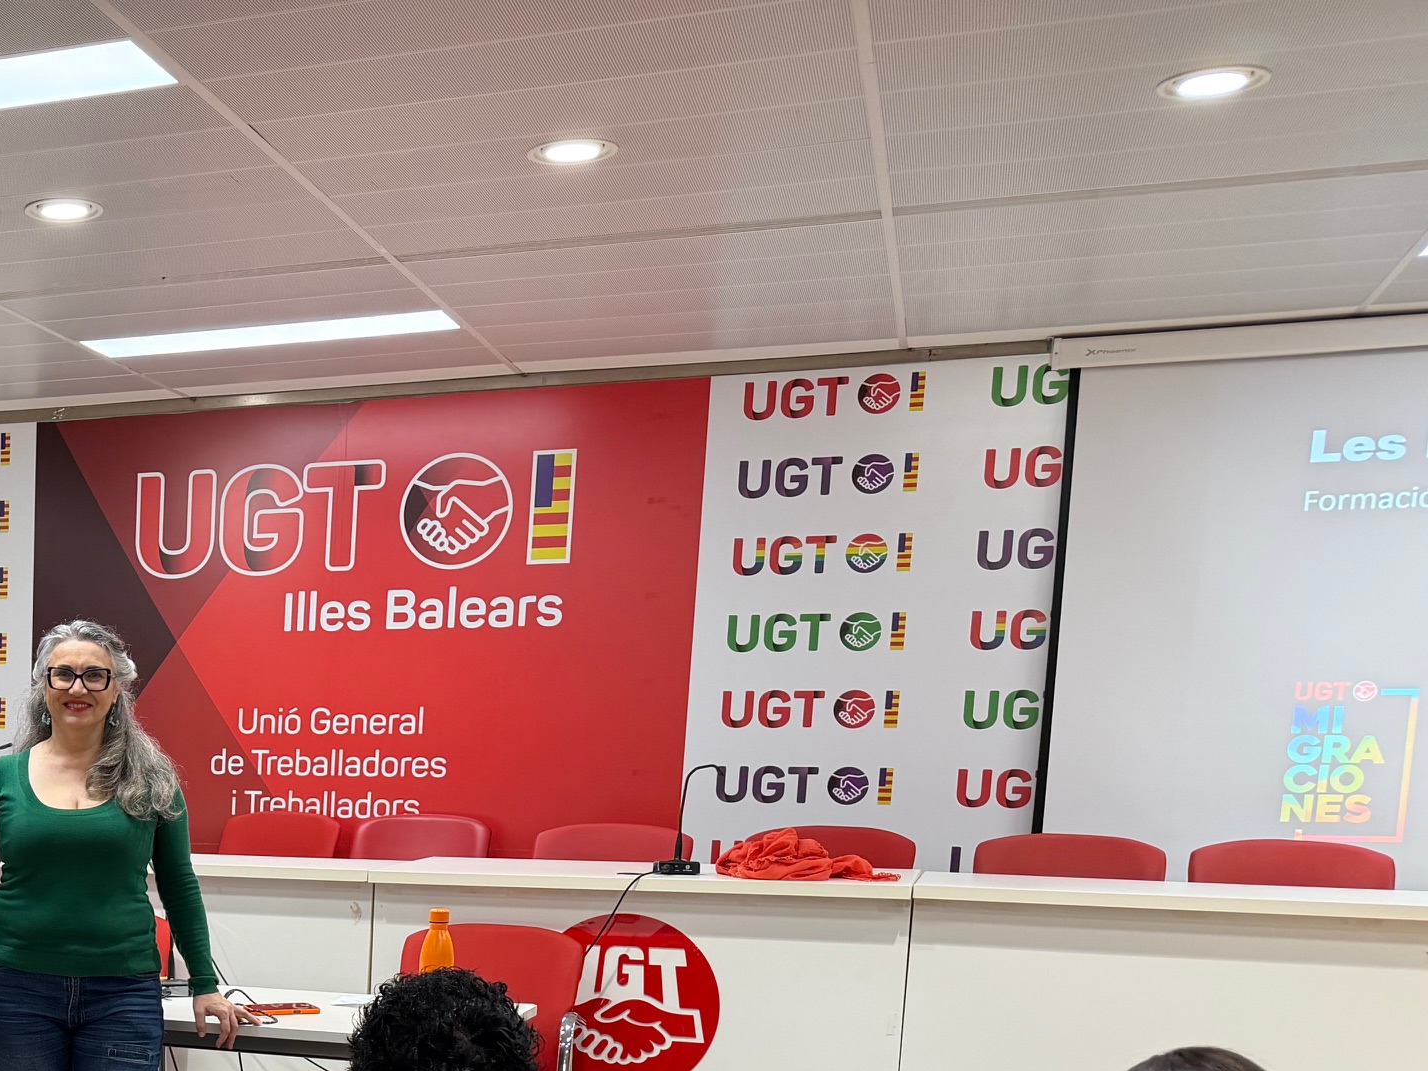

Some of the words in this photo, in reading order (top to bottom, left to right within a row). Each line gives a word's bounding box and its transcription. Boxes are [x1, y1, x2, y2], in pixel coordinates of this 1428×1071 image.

[742, 376, 850, 422] UGT
[990, 363, 1071, 408] UG
[1309, 429, 1407, 463] Les
[737, 456, 844, 499] UGT
[983, 445, 1063, 489] UG
[135, 458, 387, 580] UGT
[732, 534, 838, 577] UGT
[976, 527, 1055, 571] UG
[283, 589, 371, 633] Illes
[385, 586, 563, 631] Balears
[970, 608, 1047, 651] UG
[726, 612, 832, 653] UGT
[721, 689, 826, 729] UGT
[963, 688, 1040, 730] UG
[1294, 681, 1352, 702] UGT
[237, 706, 302, 735] Unió
[310, 706, 425, 736] General
[1290, 705, 1346, 735] MI
[210, 748, 244, 776] de
[251, 748, 447, 778] Treballadores
[1286, 735, 1385, 765] GRA
[715, 765, 820, 805] UGT
[956, 768, 1033, 809] UG
[1282, 764, 1365, 794] CIO
[230, 789, 237, 816] i
[1279, 794, 1373, 824] NES
